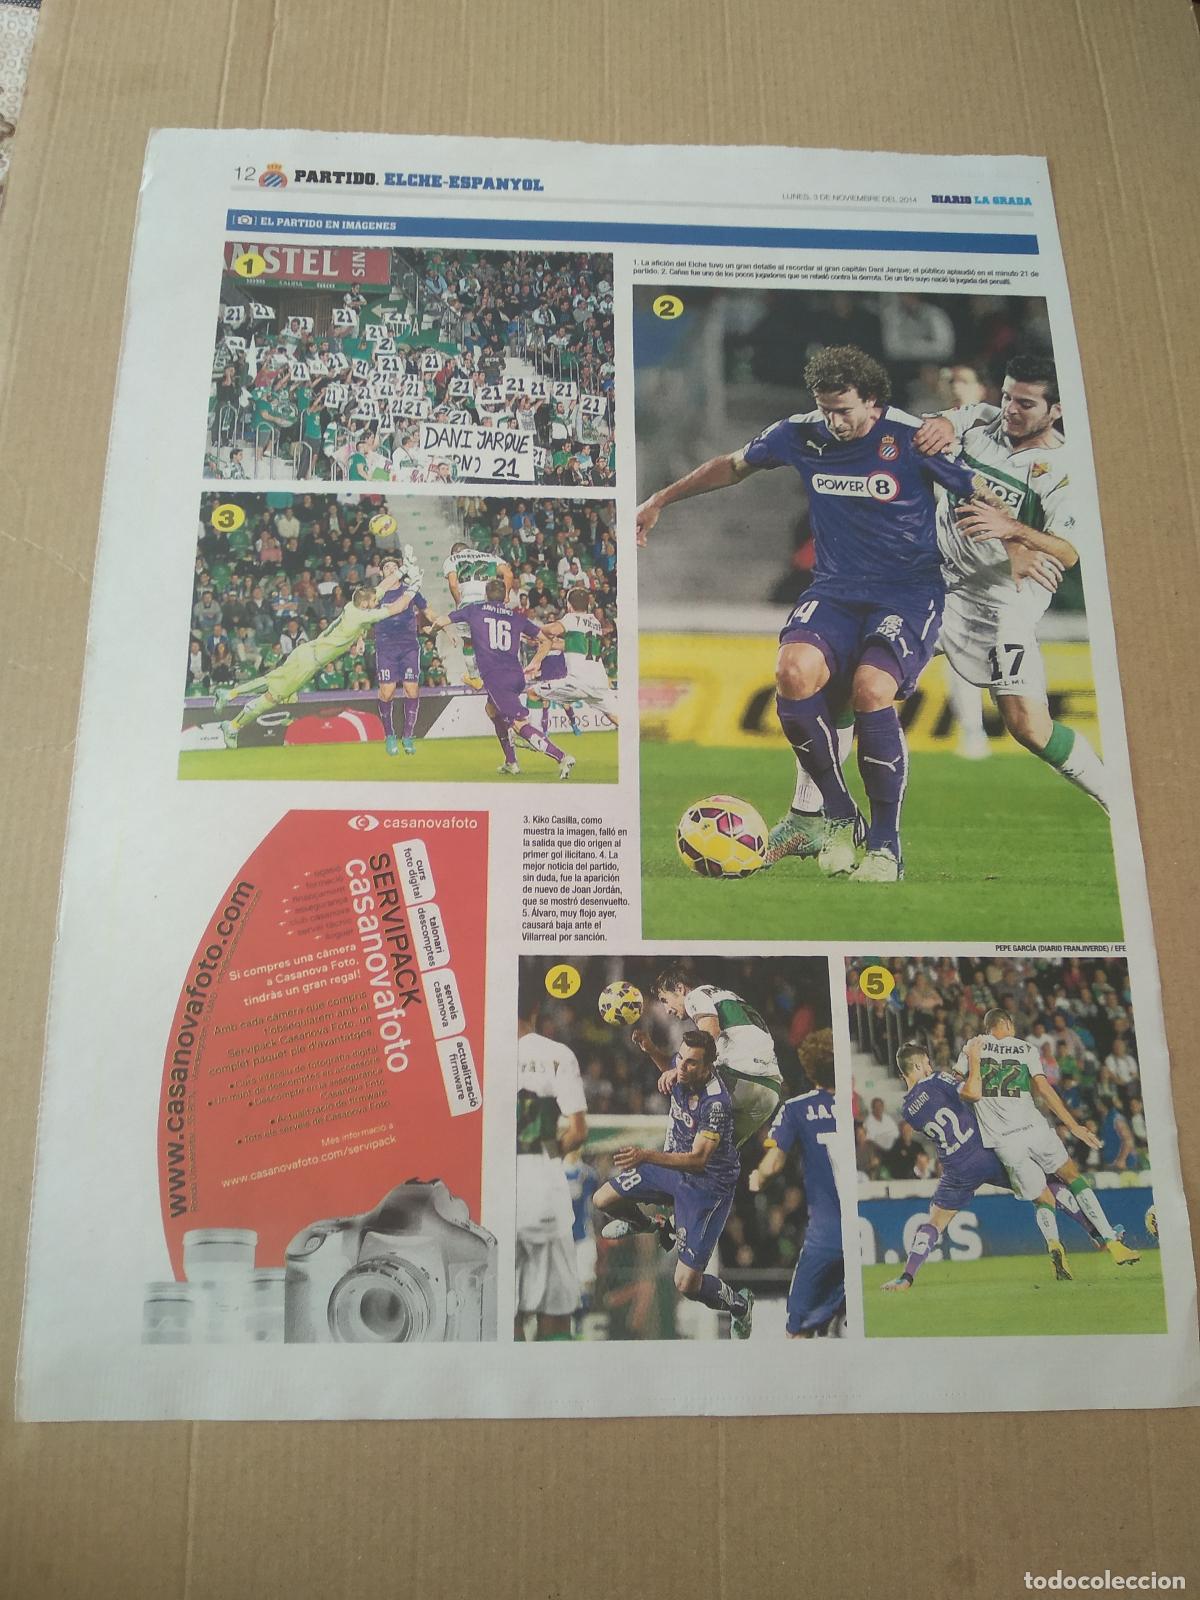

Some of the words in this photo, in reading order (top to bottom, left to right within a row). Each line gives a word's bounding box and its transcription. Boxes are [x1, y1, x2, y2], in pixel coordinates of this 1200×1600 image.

[234, 166, 256, 180] 12
[295, 170, 379, 186] PARTIDO.
[384, 172, 544, 191] ELCHE-ESPANYOL
[974, 196, 990, 205] LA
[261, 216, 274, 226] EL
[276, 217, 323, 228] PARTIDO
[325, 218, 339, 229] EN
[244, 259, 253, 274] 1
[352, 251, 365, 277] SIN
[226, 308, 240, 320] 21
[660, 301, 675, 316] 2
[337, 311, 352, 323] 21
[382, 358, 399, 371] 21
[426, 356, 439, 368] 21
[293, 365, 306, 378] 21
[453, 381, 469, 394] 21
[506, 378, 524, 392] 21
[532, 382, 546, 395] 21
[556, 384, 572, 397] 21
[583, 397, 599, 412] 21
[424, 427, 473, 449] DANI
[477, 432, 529, 453] JARQUE
[492, 458, 519, 478] 21
[817, 478, 864, 492] POWER
[875, 480, 890, 494] 8
[218, 510, 235, 528] 3
[484, 618, 511, 651] 16
[988, 644, 1024, 681] 17
[383, 816, 478, 829] casanovafoto
[551, 815, 579, 824] Casilla,
[566, 828, 597, 836] imagen,
[588, 839, 612, 848] origen
[522, 850, 548, 859] primer
[550, 850, 562, 860] gol
[404, 848, 414, 867] foto
[409, 869, 422, 899] digital
[416, 860, 426, 881] curs
[522, 862, 545, 871] mejor
[547, 862, 573, 870] noticia
[575, 862, 587, 870] del
[590, 862, 619, 871] partido,
[536, 873, 558, 882] duda,
[560, 873, 572, 881] fue
[584, 873, 619, 882] aparición
[522, 885, 532, 893] de
[592, 885, 622, 894] Jordán,
[522, 898, 537, 907] que
[550, 897, 578, 905] mostró
[531, 907, 558, 917] Álvaro,
[560, 910, 577, 918] muy
[579, 908, 596, 918] flojo
[598, 910, 616, 918] ayer,
[370, 852, 422, 1008] SERVIPACK
[556, 920, 572, 930] baja
[594, 920, 601, 928] el
[418, 907, 435, 967] descomptes
[429, 916, 444, 954] talonari
[522, 932, 556, 940] Villarreal
[574, 932, 607, 940] sanción.
[229, 970, 241, 981] Si
[244, 958, 291, 978] compres
[293, 954, 314, 965] una
[345, 859, 411, 1072] casanovafoto
[276, 966, 328, 983] Casanova
[552, 971, 571, 994] 4
[244, 988, 282, 1006] tindràs
[286, 985, 300, 996] un
[302, 980, 327, 994] gran
[330, 969, 361, 985] regal!
[866, 973, 884, 994] 5
[433, 981, 448, 1027] casanova
[444, 984, 457, 1020] serveis
[167, 880, 255, 1218] www.casanovafoto.com
[449, 1053, 464, 1100] firmware
[457, 1042, 477, 1107] actualització
[980, 1058, 1020, 1098] 22
[924, 1107, 974, 1156] 22
[222, 1135, 396, 1188] www.casanovafoto.com/servipack
